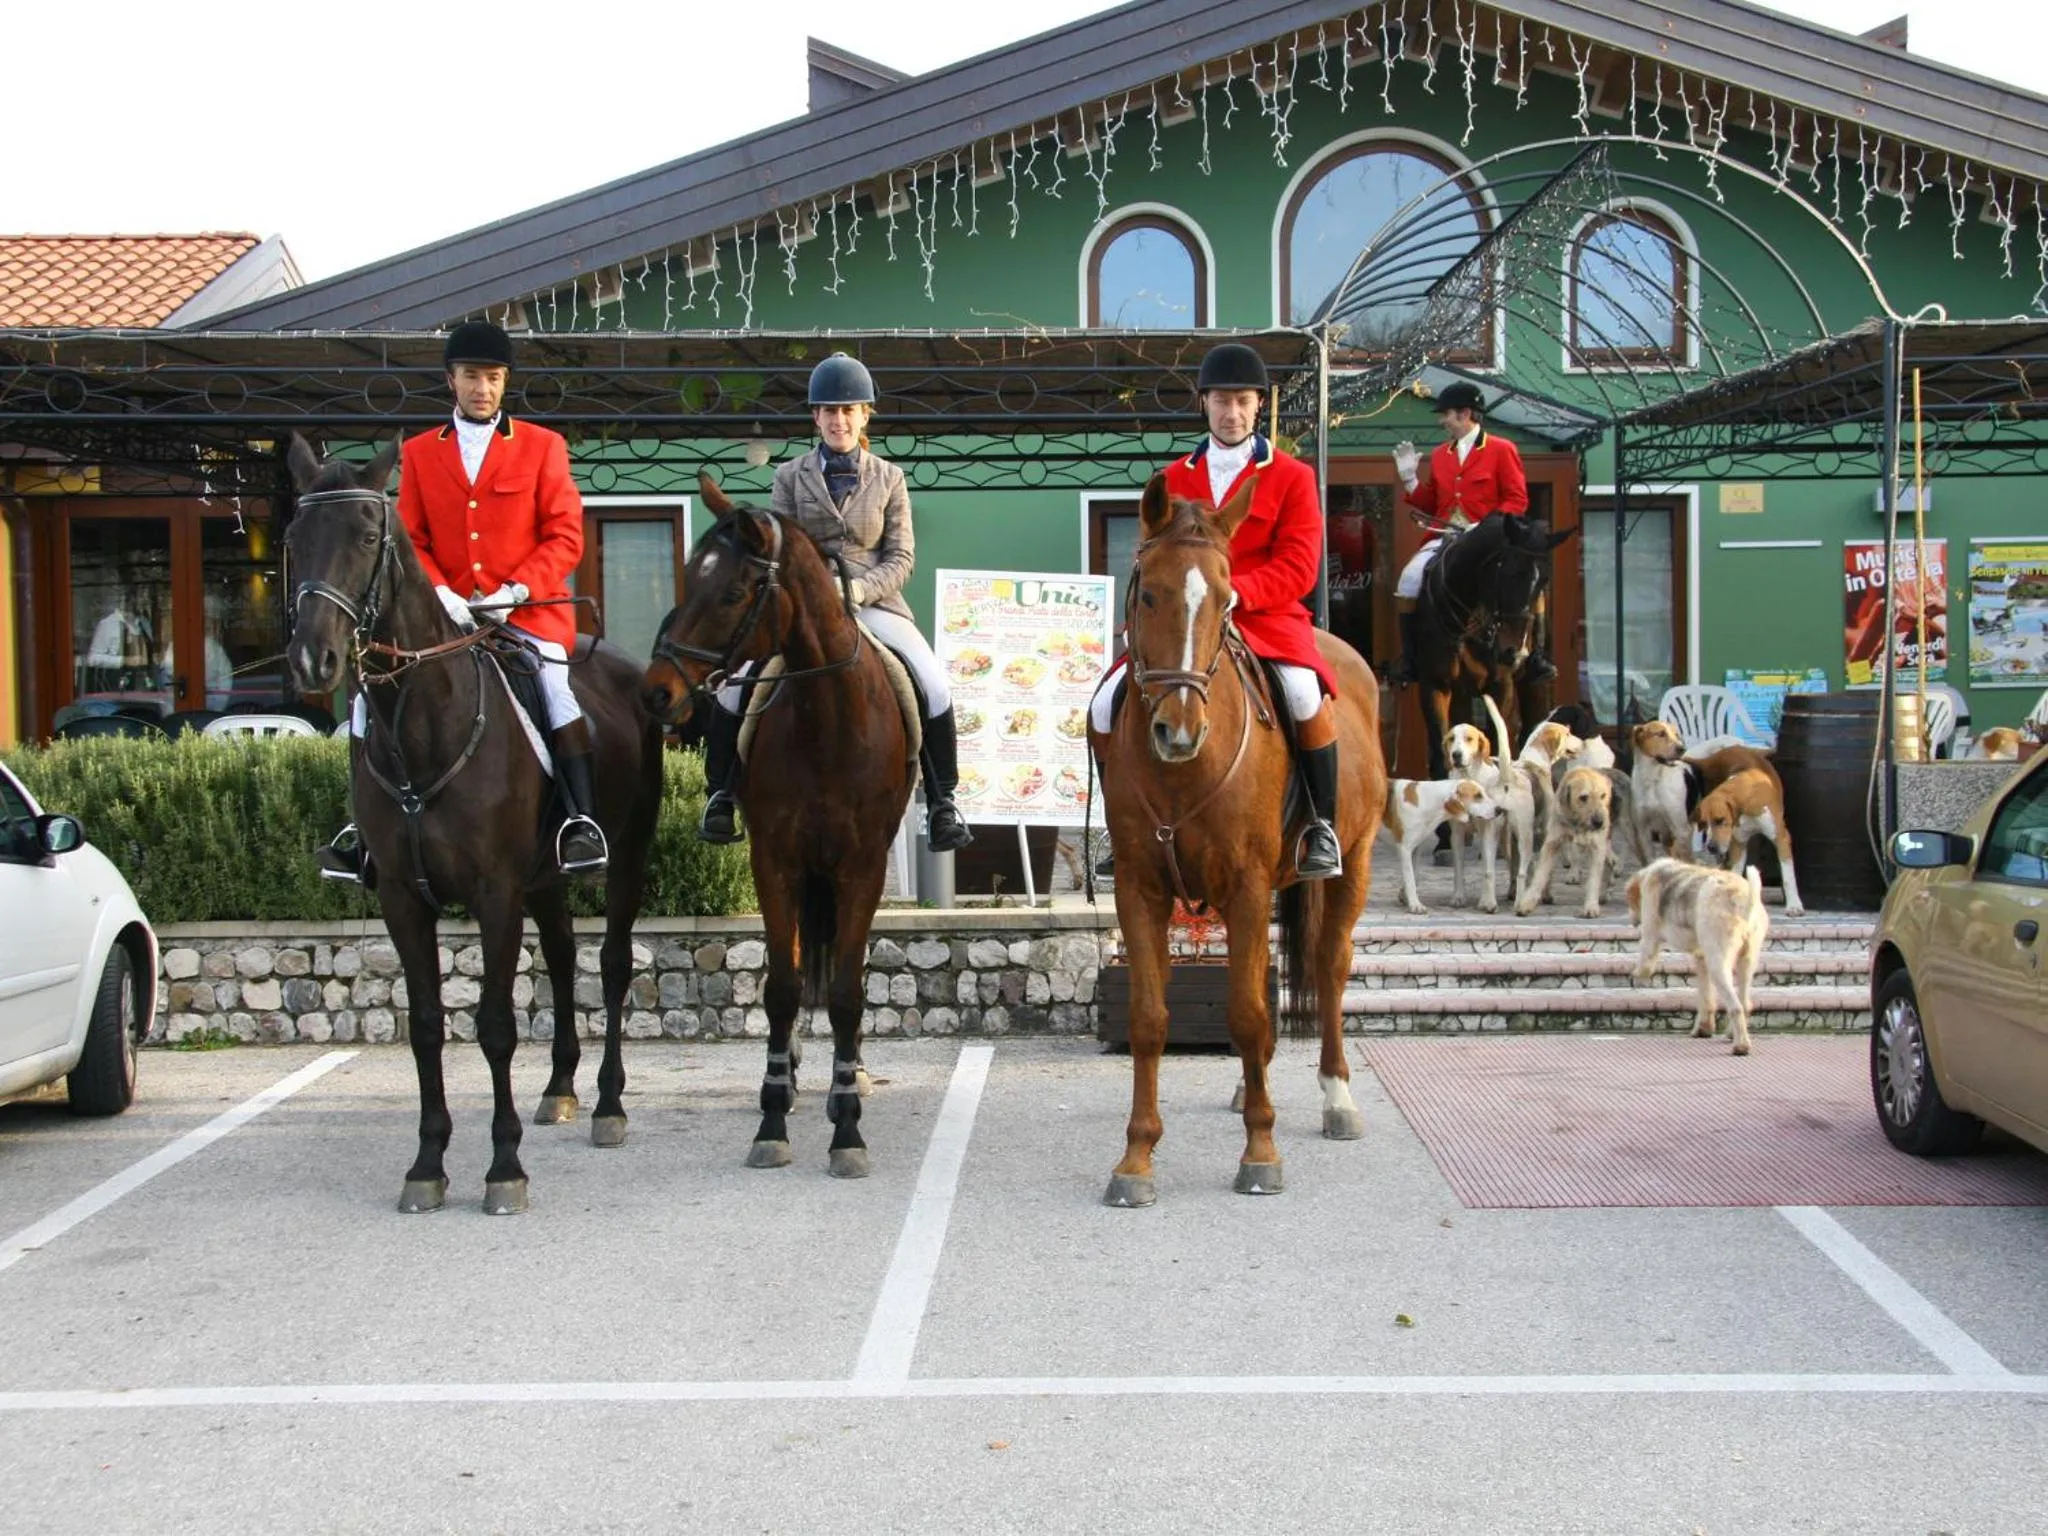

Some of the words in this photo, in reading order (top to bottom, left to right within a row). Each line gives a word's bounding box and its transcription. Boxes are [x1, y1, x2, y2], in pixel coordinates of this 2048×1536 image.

[1855, 545, 1923, 572] Muic
[1845, 574, 1867, 592] in
[1869, 561, 1943, 588] Oteia
[1895, 636, 1945, 655] Venrdì
